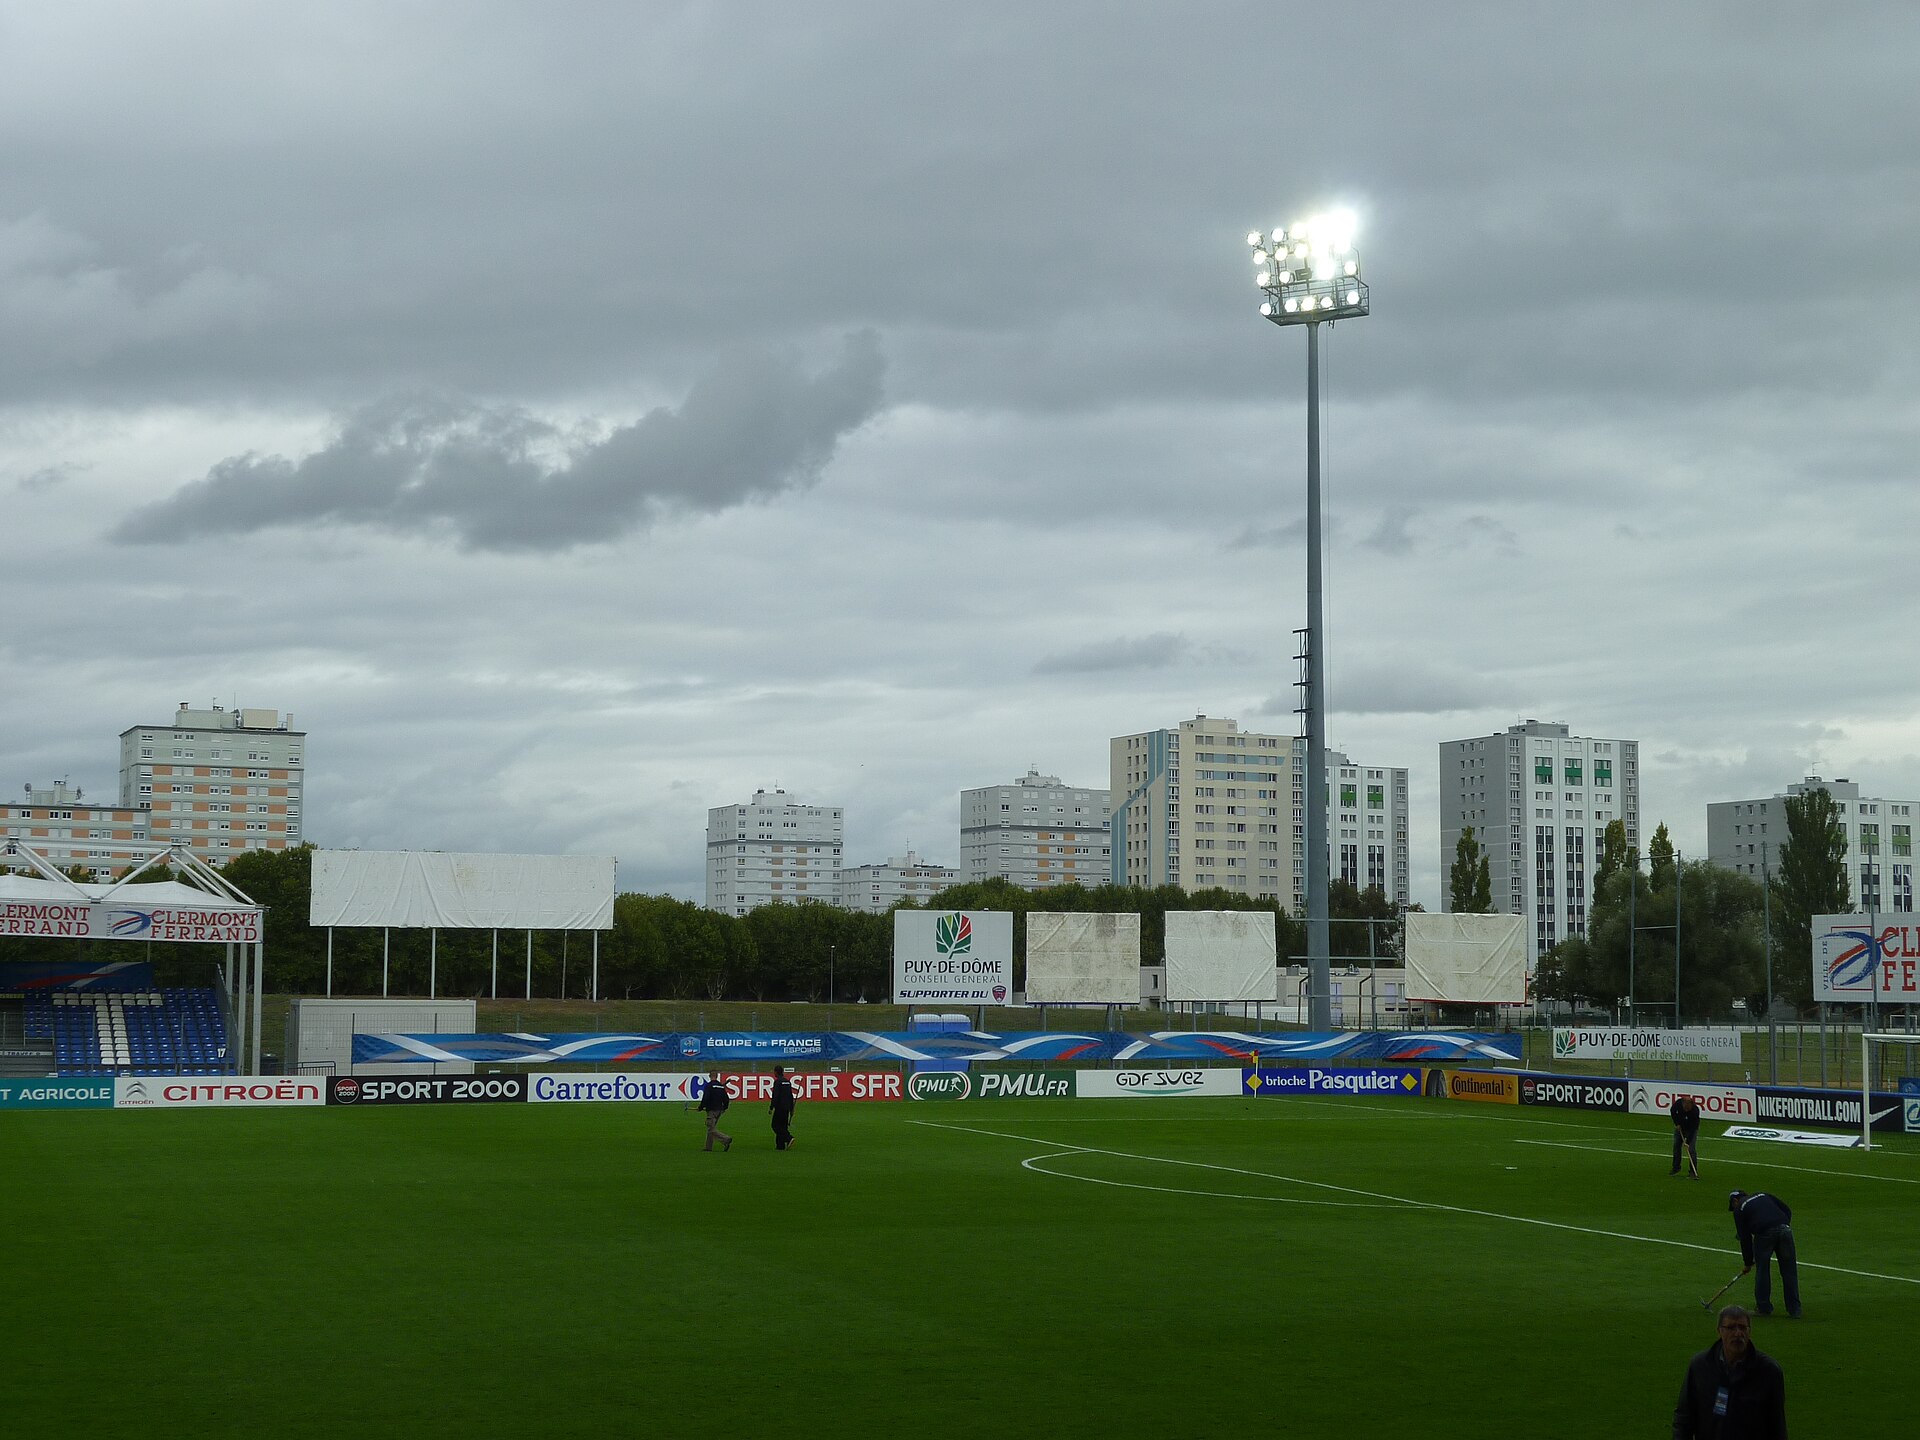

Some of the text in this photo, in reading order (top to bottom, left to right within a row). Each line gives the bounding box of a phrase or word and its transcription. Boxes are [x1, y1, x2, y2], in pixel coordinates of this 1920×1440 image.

[151, 910, 259, 926] CLERMONT
[151, 925, 257, 941] FERRAND
[1822, 940, 1828, 955] DE
[905, 958, 1001, 973] PUY-DE-DÔME
[904, 975, 1002, 983] CONSEIL GENERAL
[899, 990, 988, 998] SUPPORTER DU
[707, 1037, 751, 1047] ÉQUIPE
[771, 1039, 821, 1047] FRANCE
[1579, 1030, 1739, 1048] PUY-DE-DÔME CONSEIL GENERAL
[217, 1048, 226, 1058] 17
[1613, 1049, 1625, 1058] du
[1662, 1050, 1673, 1060] des
[1675, 1050, 1708, 1061] Hommes
[726, 1075, 775, 1099] SFR
[790, 1075, 839, 1099] SFR
[851, 1074, 901, 1099] SFR
[917, 1079, 949, 1092] PMU
[980, 1073, 1069, 1097] PMU.FR
[1115, 1071, 1152, 1086] GDF
[1265, 1069, 1398, 1094] brioche Pasquier
[1451, 1075, 1505, 1096] Continental
[19, 1088, 111, 1100] AGRICOLE
[163, 1079, 318, 1101] CITROËN
[363, 1080, 520, 1100] SPORT 2000
[535, 1075, 671, 1100] Carrefour
[1536, 1083, 1624, 1107] SPORT 2000
[1758, 1096, 1861, 1123] NIKEFOOTBALL.COM
